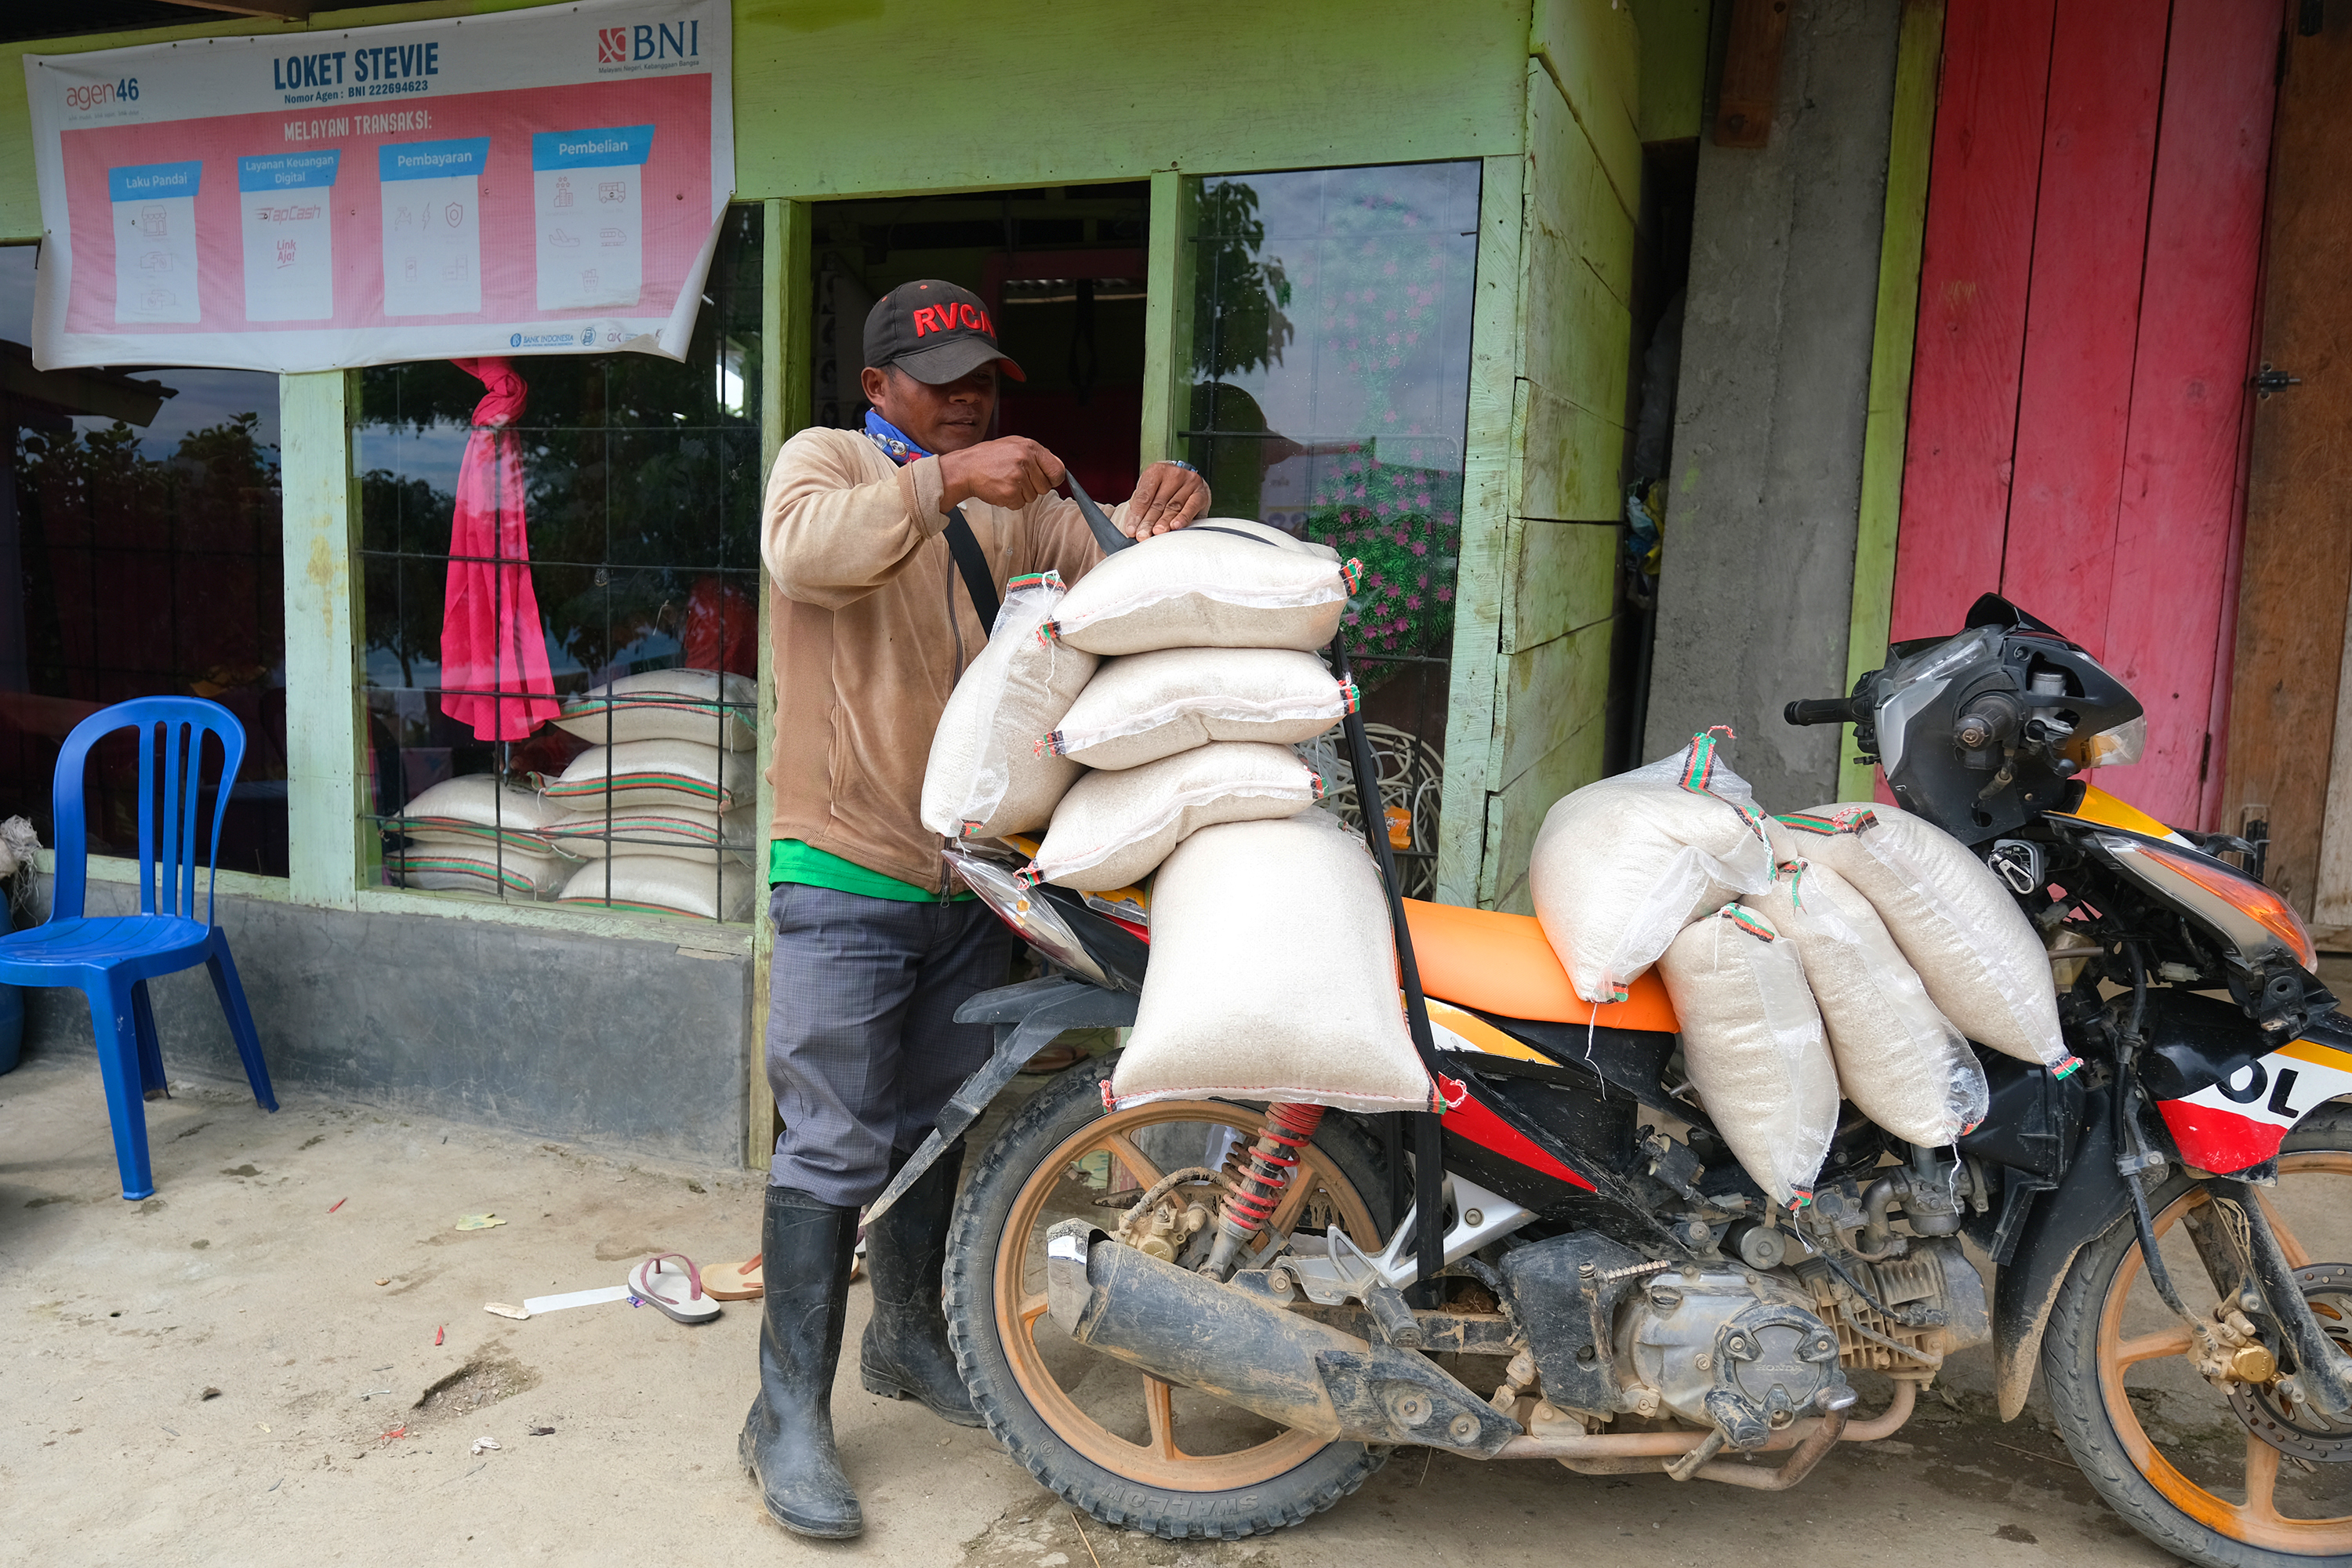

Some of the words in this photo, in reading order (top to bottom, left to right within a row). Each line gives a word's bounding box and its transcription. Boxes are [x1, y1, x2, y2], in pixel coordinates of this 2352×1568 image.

[633, 20, 699, 60] BNI
[274, 51, 347, 90] LOKET
[354, 42, 438, 82] STEVIE
[623, 64, 643, 73] Negeri,
[644, 61, 678, 71] Kebanggaan
[67, 78, 140, 111] agen46
[285, 94, 314, 104] Nomor
[315, 90, 339, 103] Agen
[348, 85, 365, 98] BNI
[368, 80, 429, 96] 222694623
[284, 117, 349, 142] MELAYANI
[354, 110, 432, 135] TRANSAKSI:
[559, 139, 629, 155] Pembelian
[245, 158, 285, 173] Layanan
[286, 155, 335, 169] Keuangan
[397, 152, 472, 167] Pembayaran
[125, 176, 151, 189] Laku
[153, 172, 188, 187] Pandai
[274, 172, 306, 185] Digital
[260, 205, 321, 226] TapCash
[277, 239, 296, 252] Link
[277, 250, 296, 264] Aja!
[523, 336, 540, 344] BANK
[540, 334, 574, 343] INDONESIA
[1101, 1482, 1259, 1517] SWALLOW
